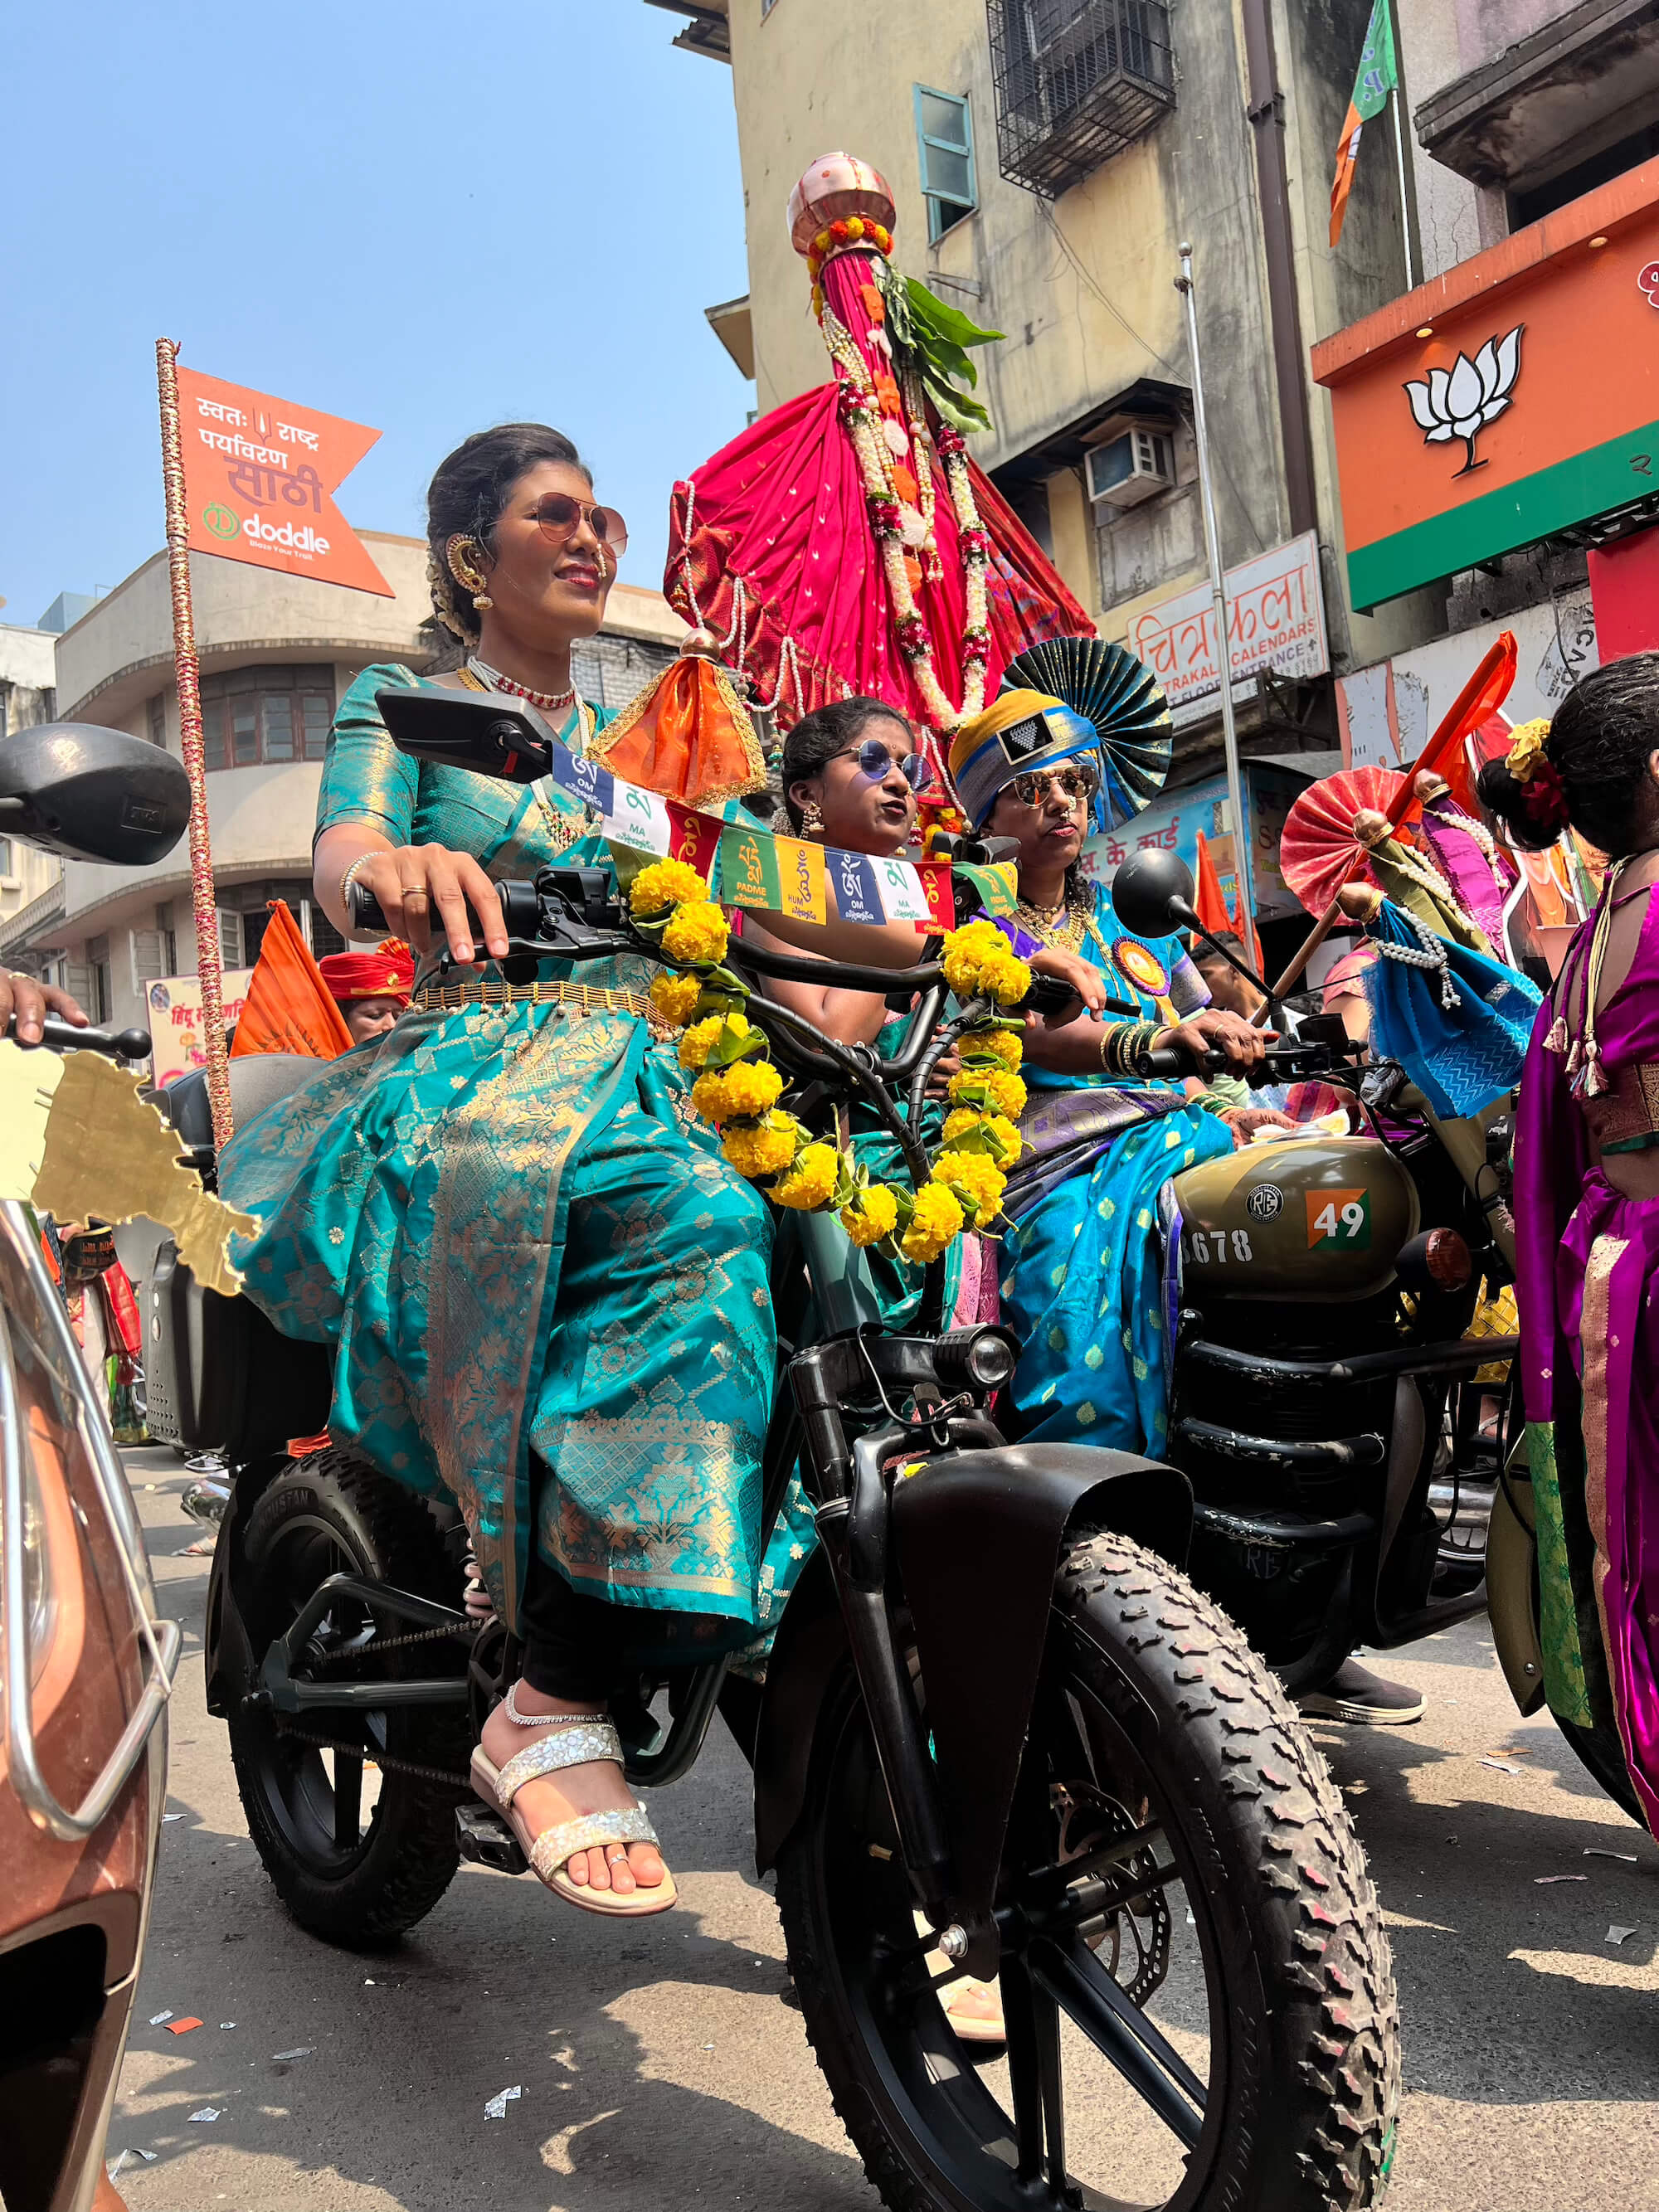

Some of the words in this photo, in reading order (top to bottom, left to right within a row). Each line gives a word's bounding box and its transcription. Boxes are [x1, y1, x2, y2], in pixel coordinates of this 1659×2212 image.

[197, 397, 248, 426] स्वतः
[276, 421, 319, 452] राष्ट्र
[198, 428, 289, 470] पर्यावरण
[223, 455, 324, 514] साठी
[243, 513, 330, 555] doddle
[1135, 564, 1308, 673] चित्रकला
[1164, 663, 1219, 694] TRAKAL
[1231, 618, 1316, 667] CALENDARS
[577, 778, 594, 793] OM
[630, 824, 646, 837] MA
[736, 882, 766, 897] PADME
[788, 894, 804, 907] HUM
[851, 900, 864, 910] OM
[898, 900, 910, 908] MA
[1313, 1203, 1365, 1237] 49
